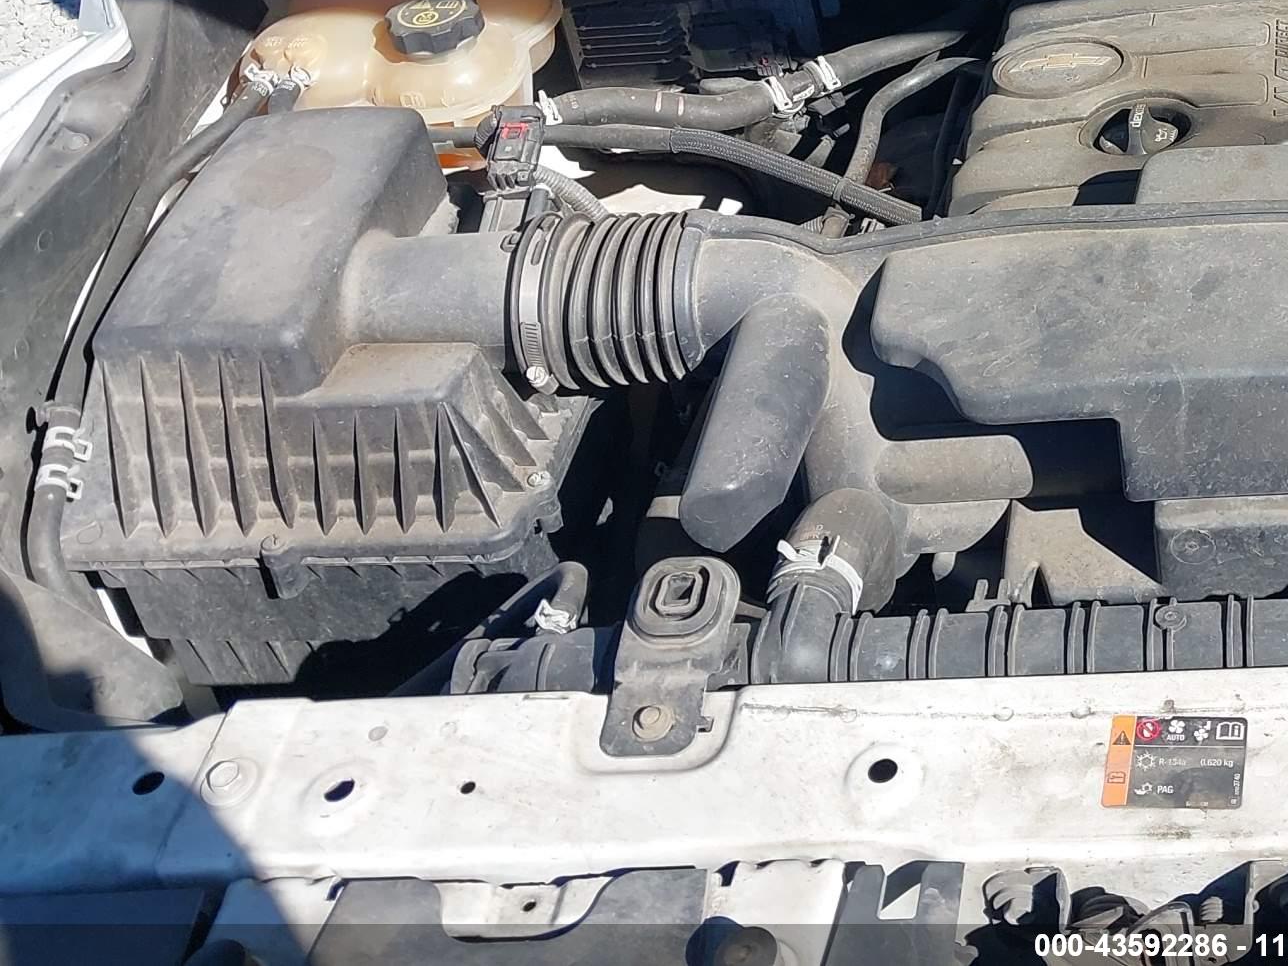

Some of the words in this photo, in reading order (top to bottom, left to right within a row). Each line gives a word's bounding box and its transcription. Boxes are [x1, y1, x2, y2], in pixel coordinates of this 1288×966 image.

[1166, 734, 1186, 742] AUTO
[1223, 758, 1234, 768] kg
[1157, 785, 1175, 794] PAG
